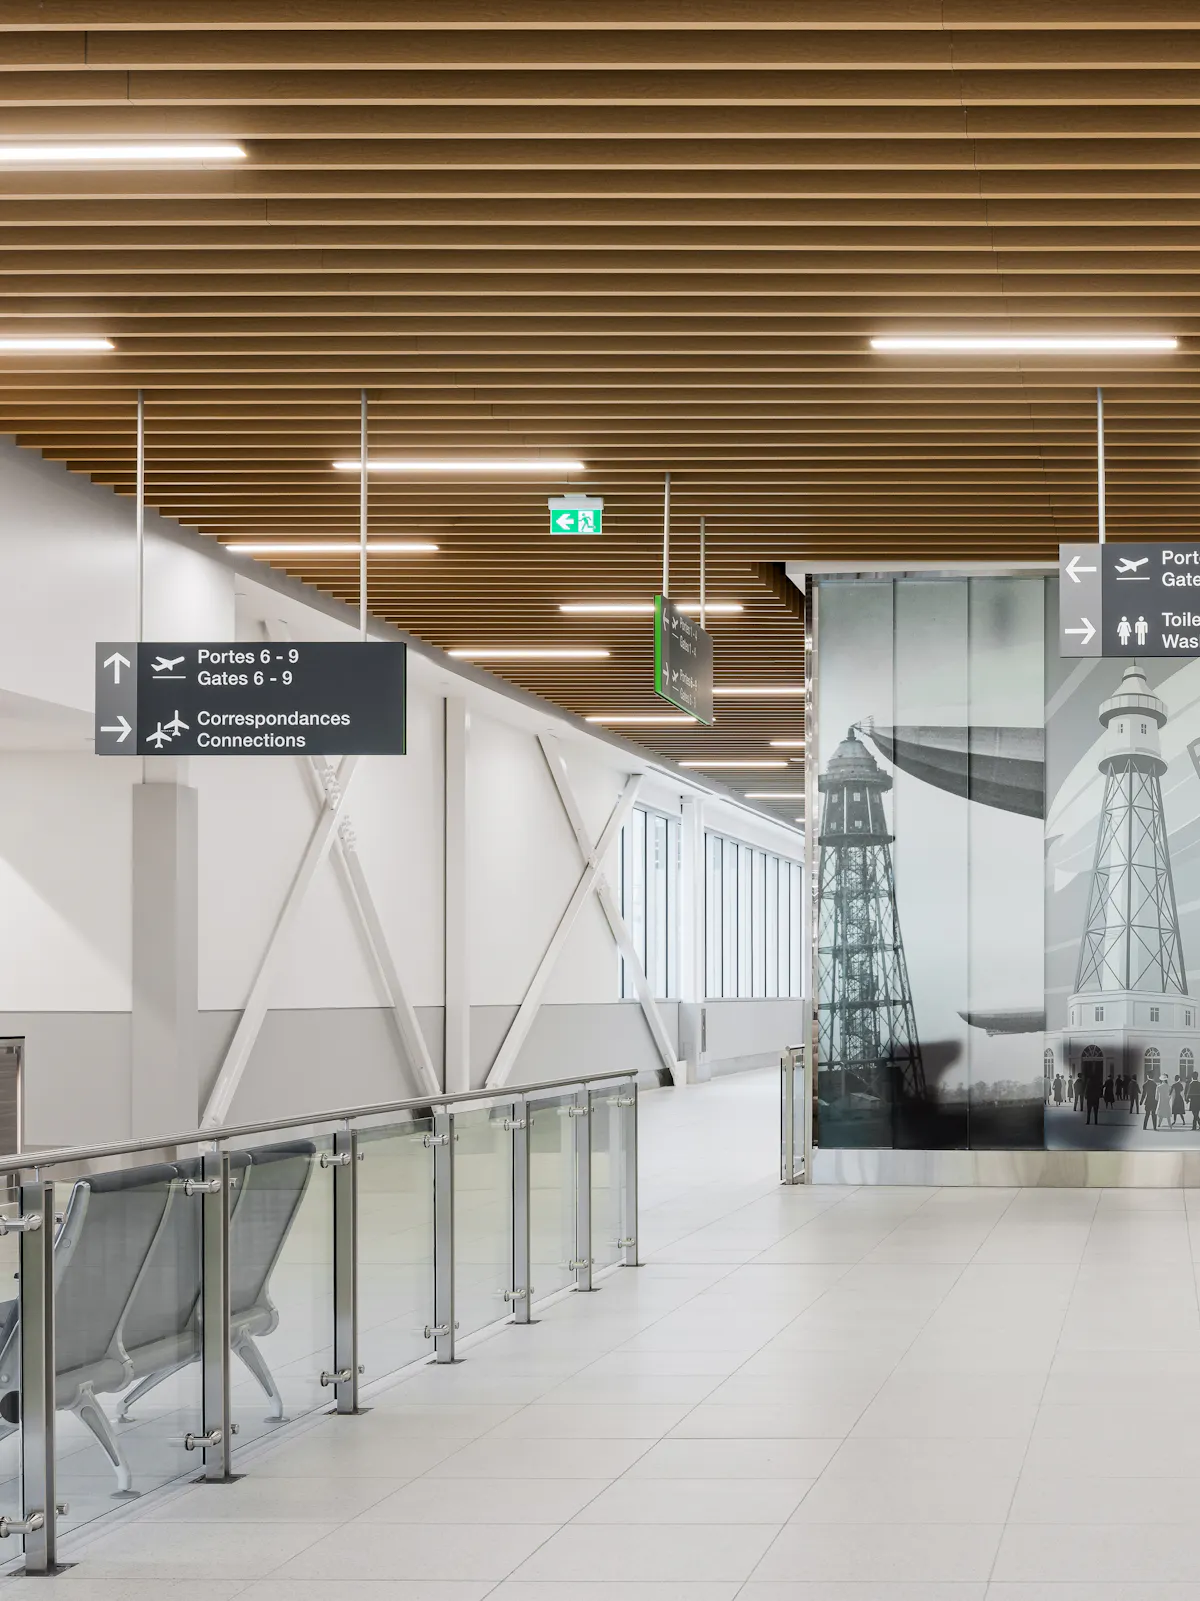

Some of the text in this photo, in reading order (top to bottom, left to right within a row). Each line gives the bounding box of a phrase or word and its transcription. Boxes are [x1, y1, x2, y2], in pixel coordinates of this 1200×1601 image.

[197, 648, 256, 665] Portes
[259, 648, 271, 665] 6
[288, 648, 299, 664] 9
[197, 670, 249, 686] Gates
[253, 670, 265, 686] 6
[281, 670, 293, 686] 9
[197, 710, 351, 729] Correspondances
[197, 732, 306, 748] Connections
